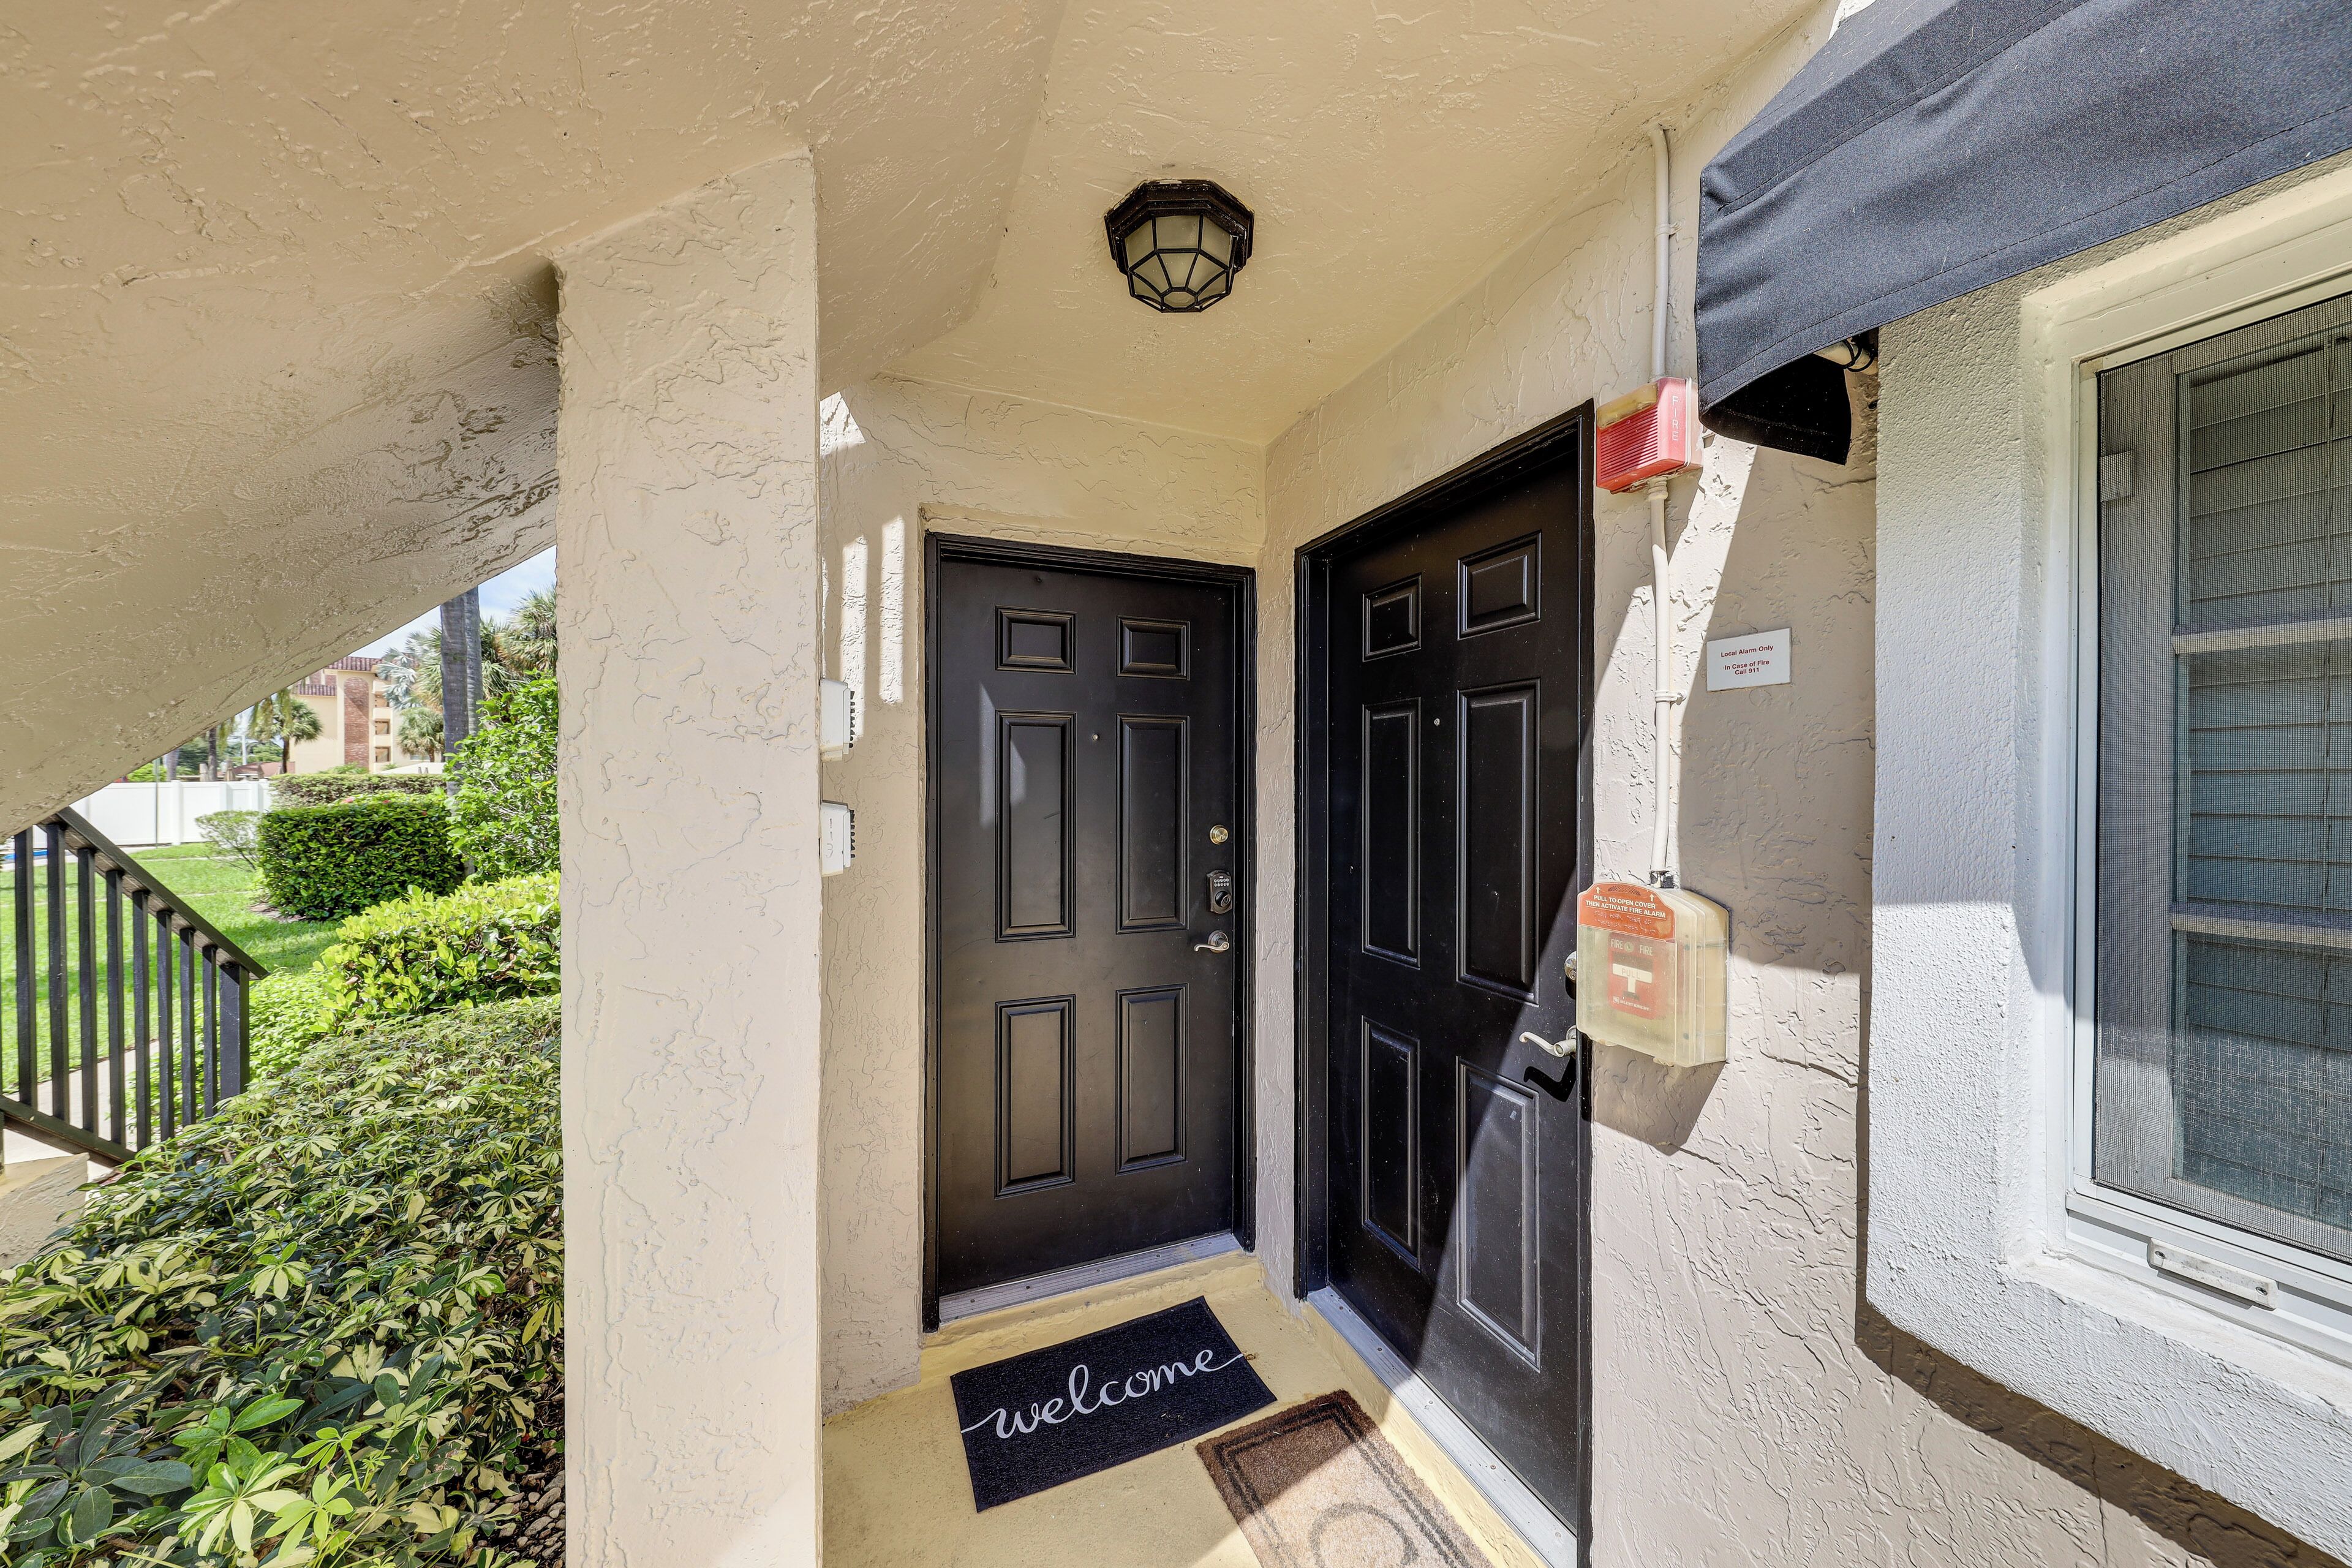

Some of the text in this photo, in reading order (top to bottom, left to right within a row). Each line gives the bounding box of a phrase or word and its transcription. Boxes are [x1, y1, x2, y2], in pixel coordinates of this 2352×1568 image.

[1602, 902, 1628, 912] ACTIVATE
[1644, 910, 1665, 918] ALARM
[1635, 900, 1656, 909] COVER
[1611, 938, 1653, 956] FIRE FIRE
[1621, 968, 1640, 979] PULL
[960, 1349, 1245, 1439] welcome
